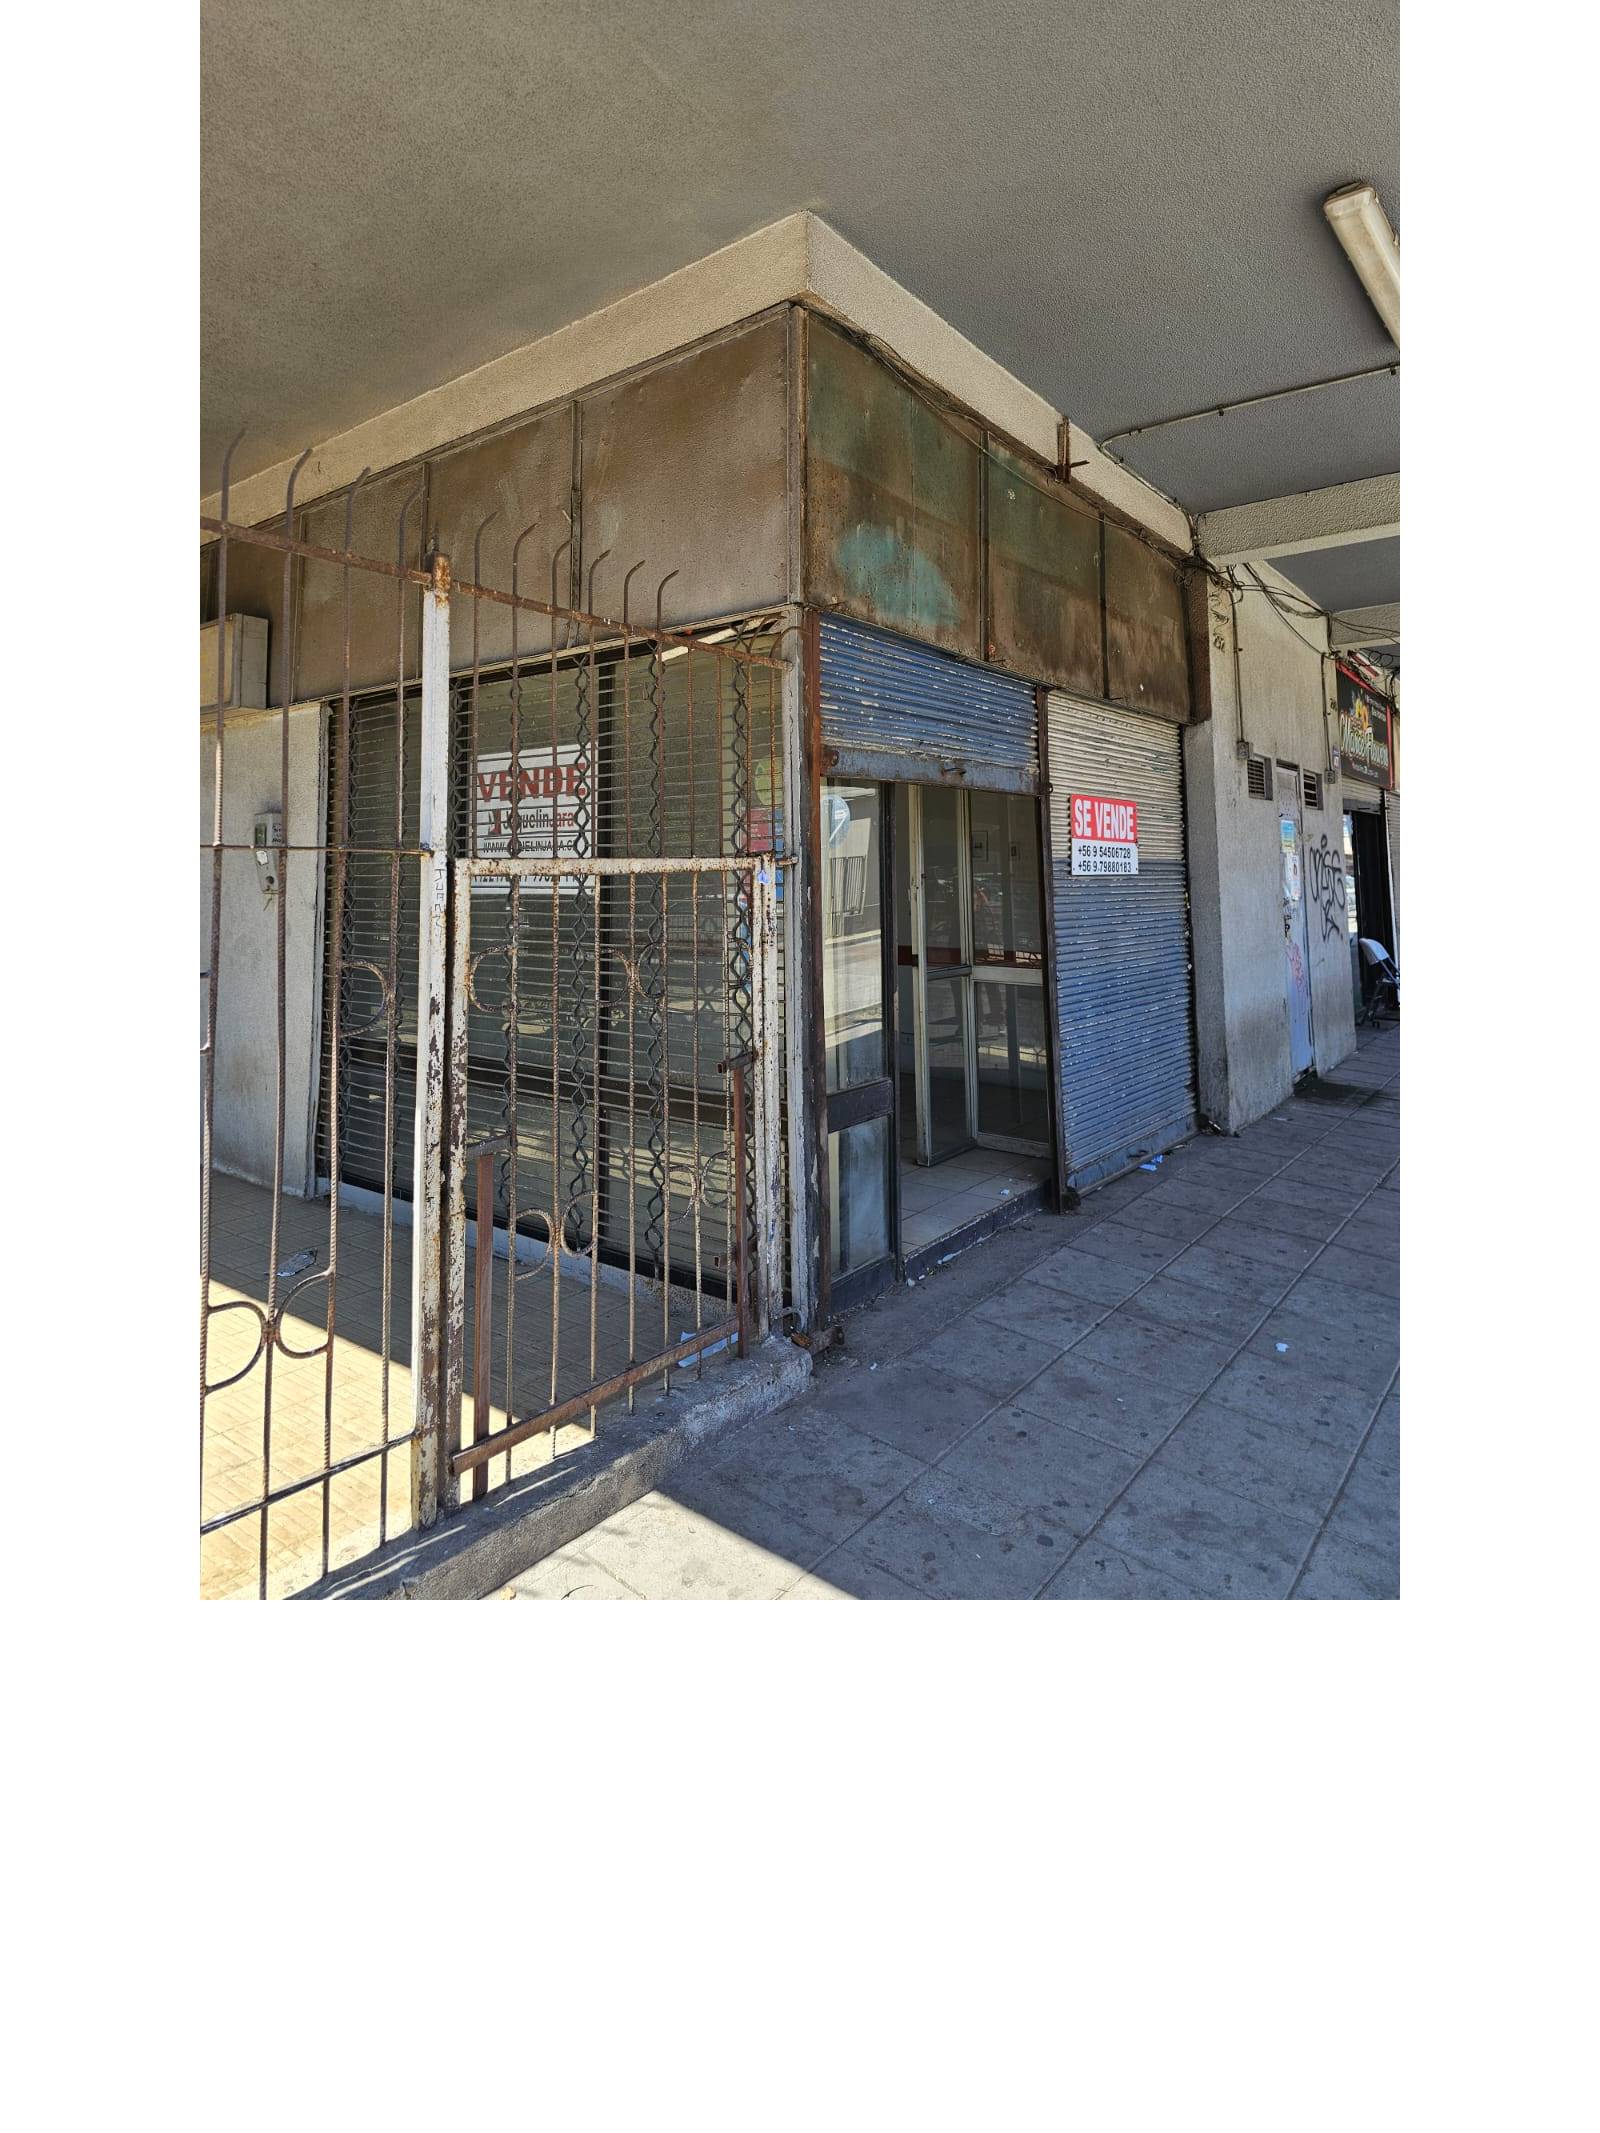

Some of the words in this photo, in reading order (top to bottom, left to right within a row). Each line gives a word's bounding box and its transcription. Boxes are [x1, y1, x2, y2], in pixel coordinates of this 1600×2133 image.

[477, 763, 586, 802] VENDE
[1075, 798, 1092, 837] SE
[1094, 801, 1135, 840] VENDE
[1078, 845, 1091, 857] +56
[1092, 846, 1098, 857] 9
[1099, 846, 1131, 859] 54506728
[1078, 860, 1091, 872] +56
